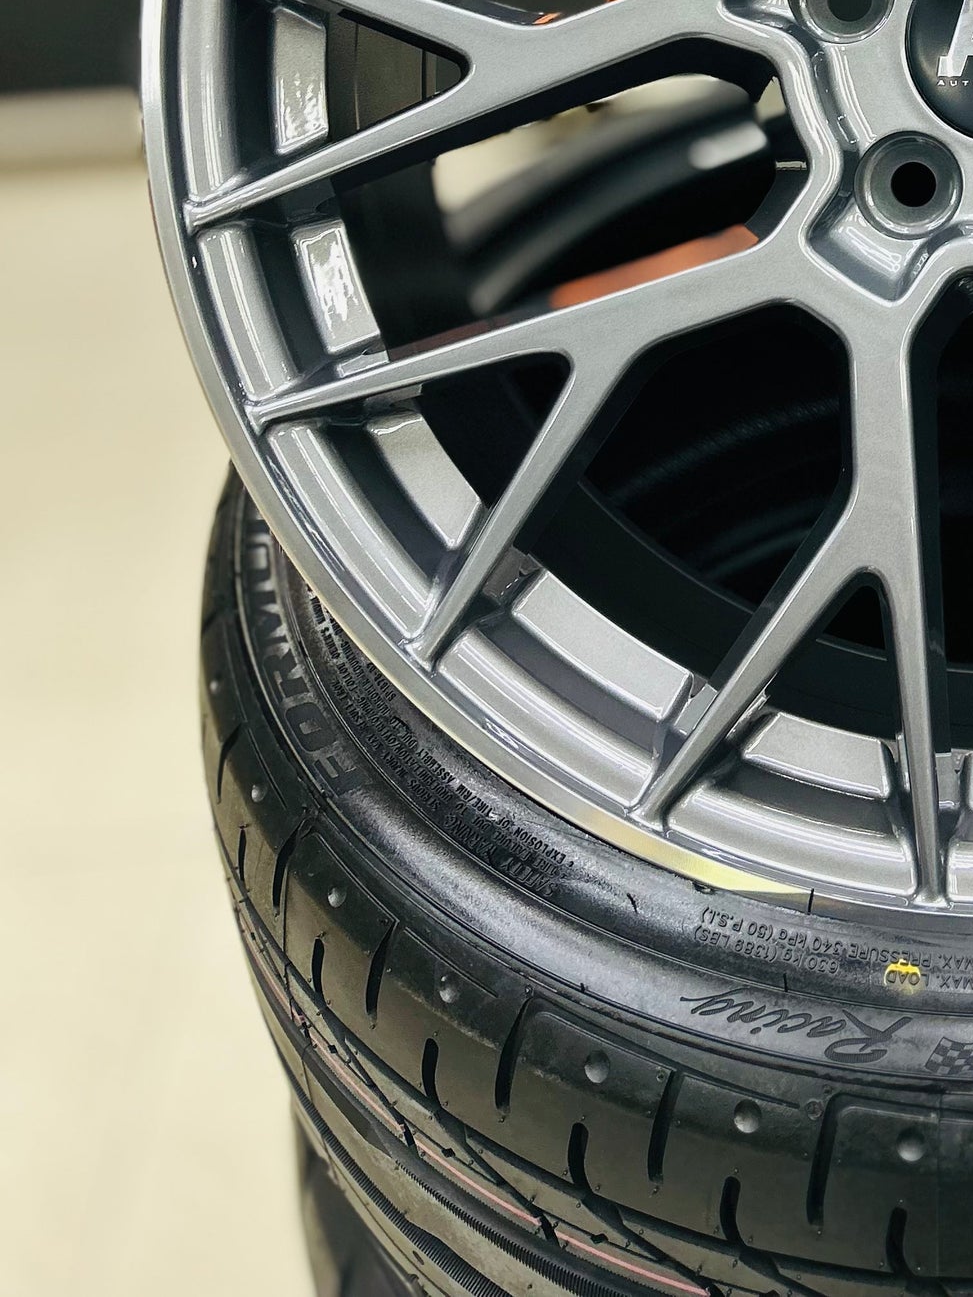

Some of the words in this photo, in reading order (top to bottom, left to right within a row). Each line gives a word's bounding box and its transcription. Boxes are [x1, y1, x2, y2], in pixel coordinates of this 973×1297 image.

[511, 825, 567, 865] EXPLOSION
[692, 925, 730, 948] LBS)
[746, 919, 775, 942] (50
[810, 935, 845, 957] 340
[847, 943, 931, 968] PRESSURE
[885, 969, 929, 987] LOAD
[680, 986, 912, 1063] Racing
